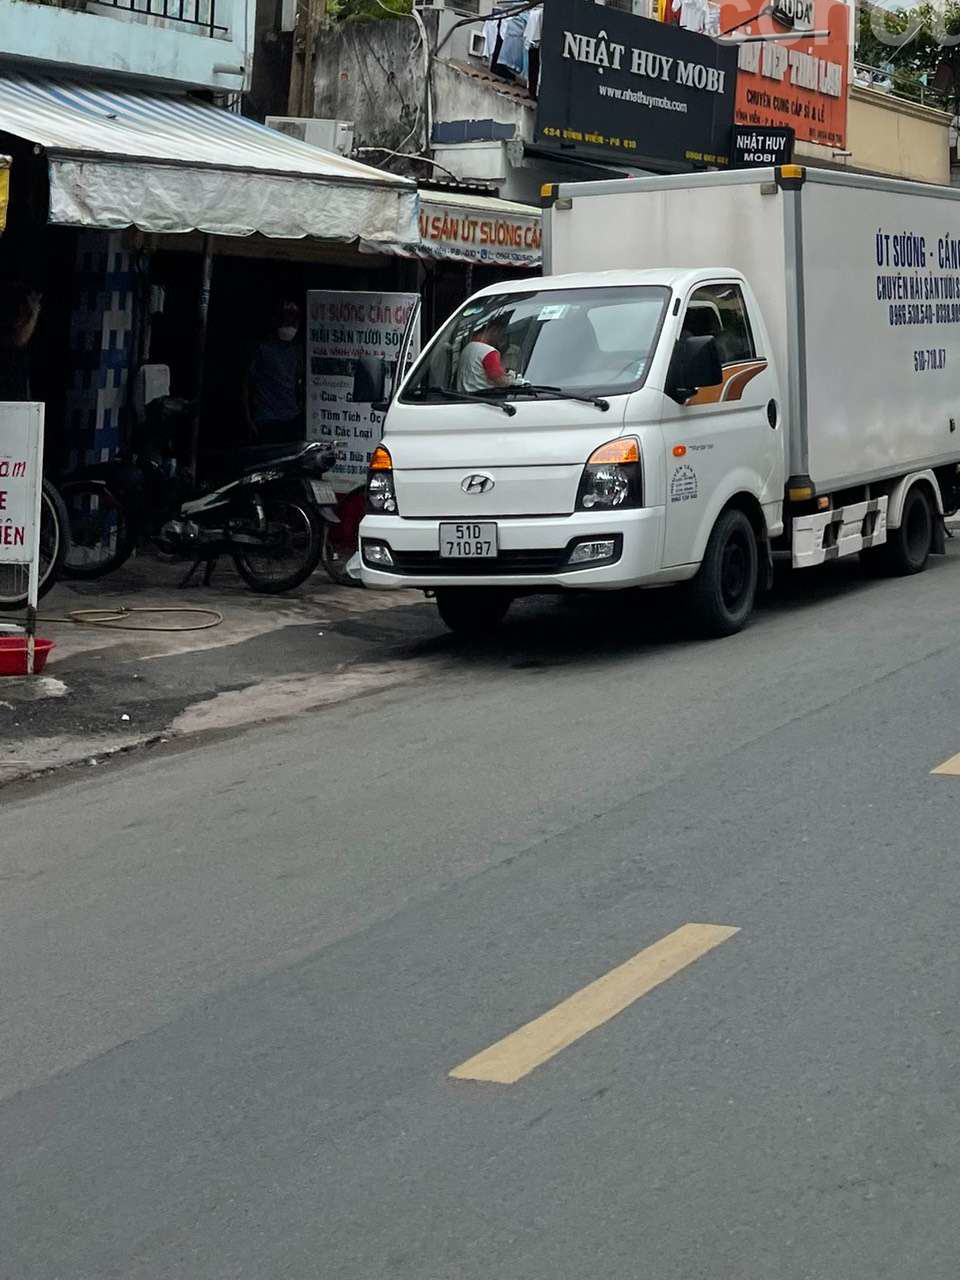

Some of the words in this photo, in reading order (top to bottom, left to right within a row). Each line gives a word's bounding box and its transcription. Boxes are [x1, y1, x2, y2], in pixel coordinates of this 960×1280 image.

[562, 30, 625, 74] NHẬT
[630, 48, 673, 81] HUY
[676, 60, 726, 94] MOBI
[599, 85, 688, 113] www.nhathuymobi.com
[736, 132, 764, 152] NHẬT
[765, 136, 786, 150] HUY
[743, 153, 776, 162] MOBI
[431, 209, 459, 241] SẢN
[461, 214, 478, 244] ÚT
[876, 227, 890, 267] ÚT
[893, 231, 926, 268] SƯƠNG
[876, 272, 908, 300] CHUYÊN
[909, 270, 923, 300] HẢI
[456, 524, 481, 539] 51D
[446, 541, 491, 556] 710.87
